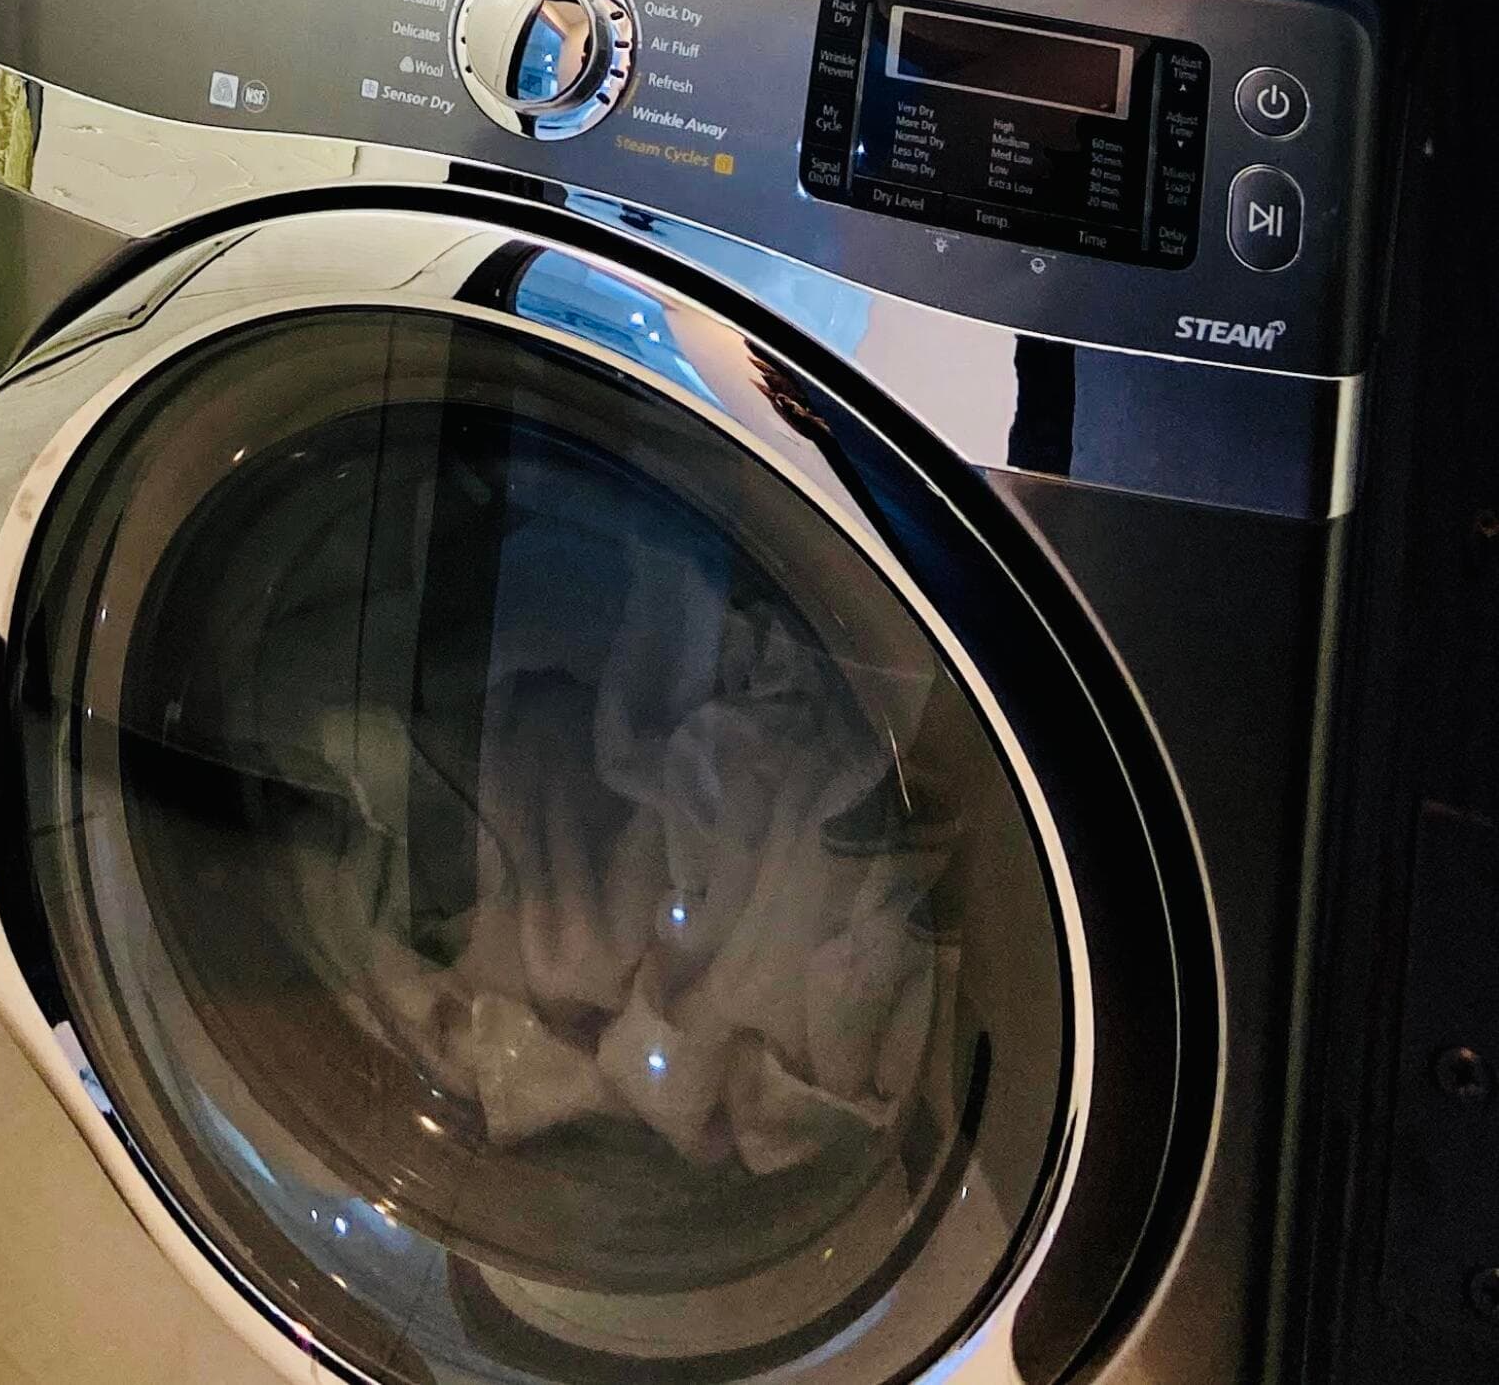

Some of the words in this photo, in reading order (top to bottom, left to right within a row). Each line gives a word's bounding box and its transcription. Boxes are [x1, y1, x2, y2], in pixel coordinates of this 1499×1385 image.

[645, 1, 678, 21] Quick
[681, 8, 702, 27] Dry
[833, 11, 852, 27] Dry
[392, 20, 441, 42] Delicates
[650, 36, 669, 52] Air
[671, 40, 700, 59] Fluff
[820, 49, 856, 65] Wrinkle
[415, 59, 444, 78] Wool
[818, 63, 854, 80] Prevent
[648, 72, 694, 94] Refresh
[381, 85, 429, 108] Sensor
[430, 95, 455, 114] Dry
[823, 104, 839, 120] My
[898, 101, 917, 116] Very
[919, 104, 935, 119] Dry
[632, 105, 684, 129] Wrinkle
[684, 117, 728, 141] Away
[815, 117, 842, 132] Cycle
[896, 115, 919, 129] More
[921, 120, 938, 134] Dry
[993, 117, 1015, 134] High
[895, 129, 927, 144] Normal
[929, 136, 945, 150] Dry
[992, 133, 1030, 150] Medium
[614, 135, 661, 157] Steam
[664, 146, 709, 167] Cycles
[893, 144, 912, 156] Less
[914, 148, 929, 162] Dry
[991, 147, 1012, 161] Med
[1013, 152, 1033, 165] Low
[811, 156, 841, 173] Signal
[891, 158, 918, 173] Damp
[920, 164, 936, 178] Dry
[989, 162, 1009, 175] Low
[808, 170, 841, 187] On/Off
[988, 177, 1011, 190] Extra
[1014, 181, 1033, 195] Low
[873, 188, 893, 206] Dry
[895, 193, 925, 211] Level
[1079, 230, 1107, 248] Time
[1158, 226, 1188, 245] Delay
[1160, 241, 1184, 256] Start
[1174, 316, 1276, 351] STEAM
